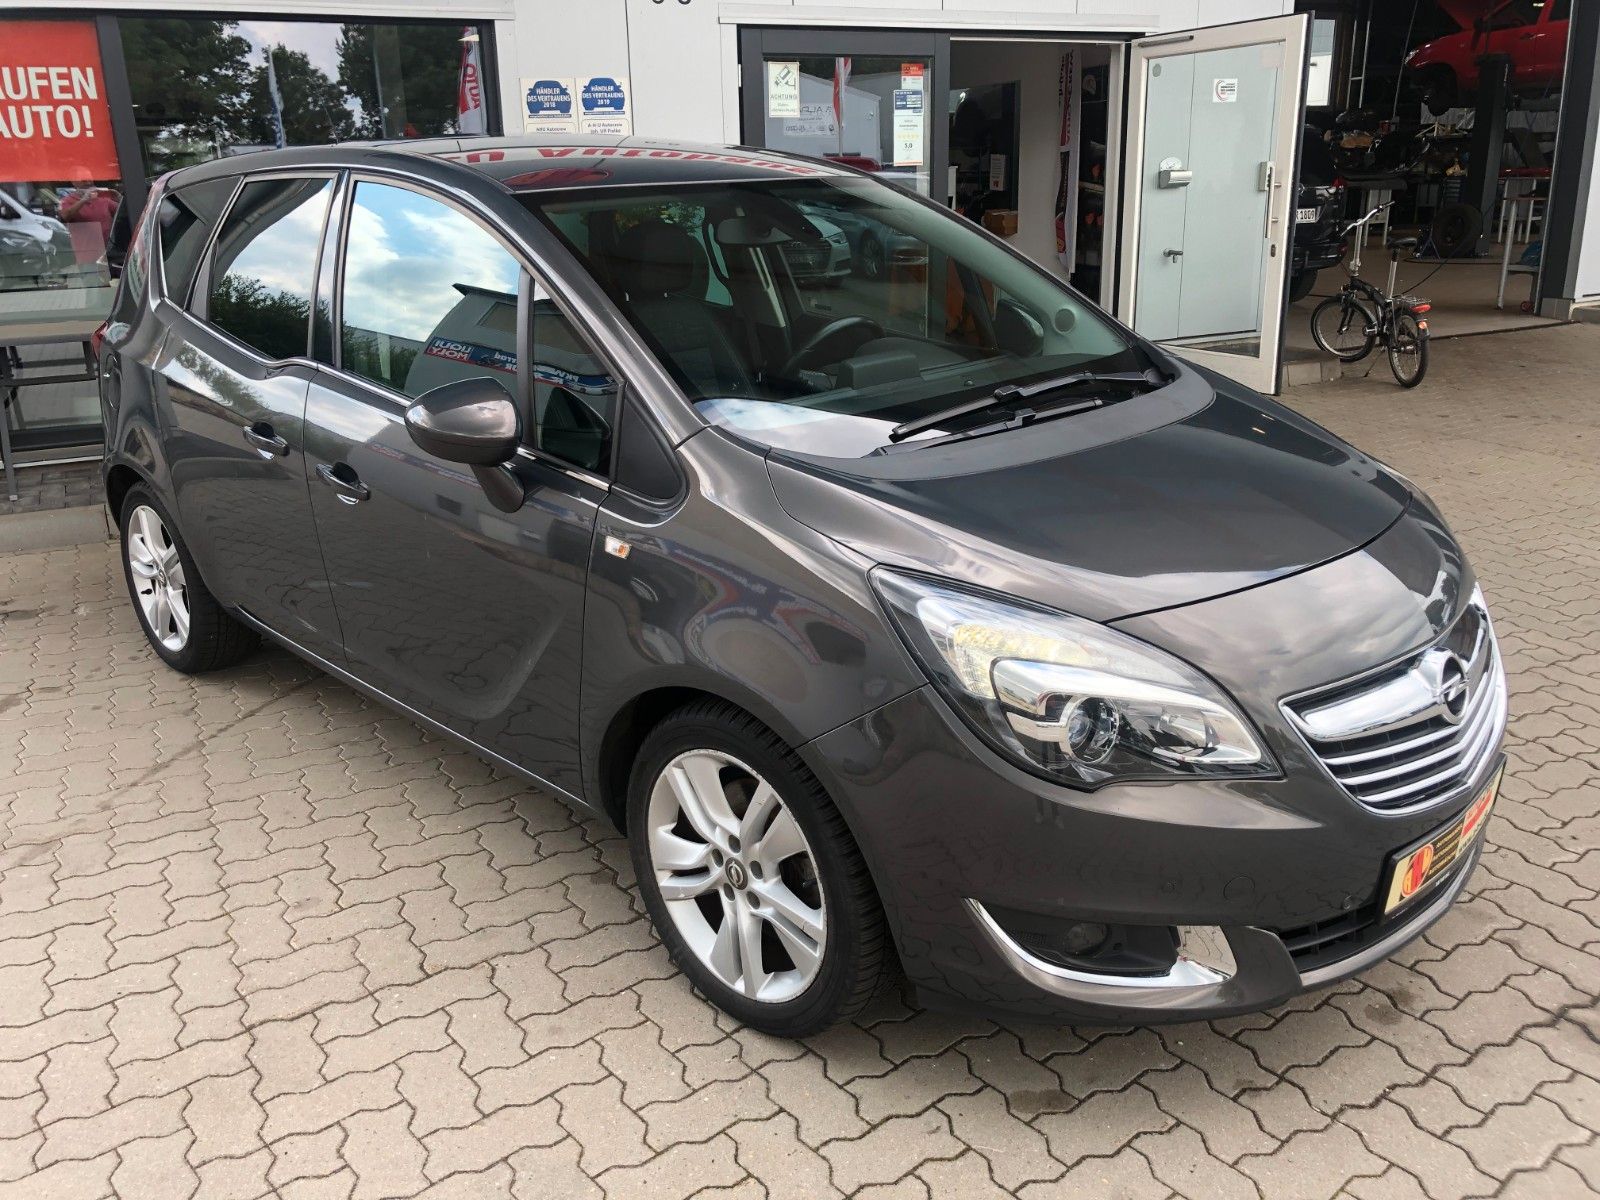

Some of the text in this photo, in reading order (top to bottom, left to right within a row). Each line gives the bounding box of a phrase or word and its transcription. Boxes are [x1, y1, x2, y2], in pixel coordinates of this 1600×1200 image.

[0, 66, 98, 100] UFEN
[536, 86, 560, 95] HÄNDLER
[591, 84, 614, 92] HÄNDLER
